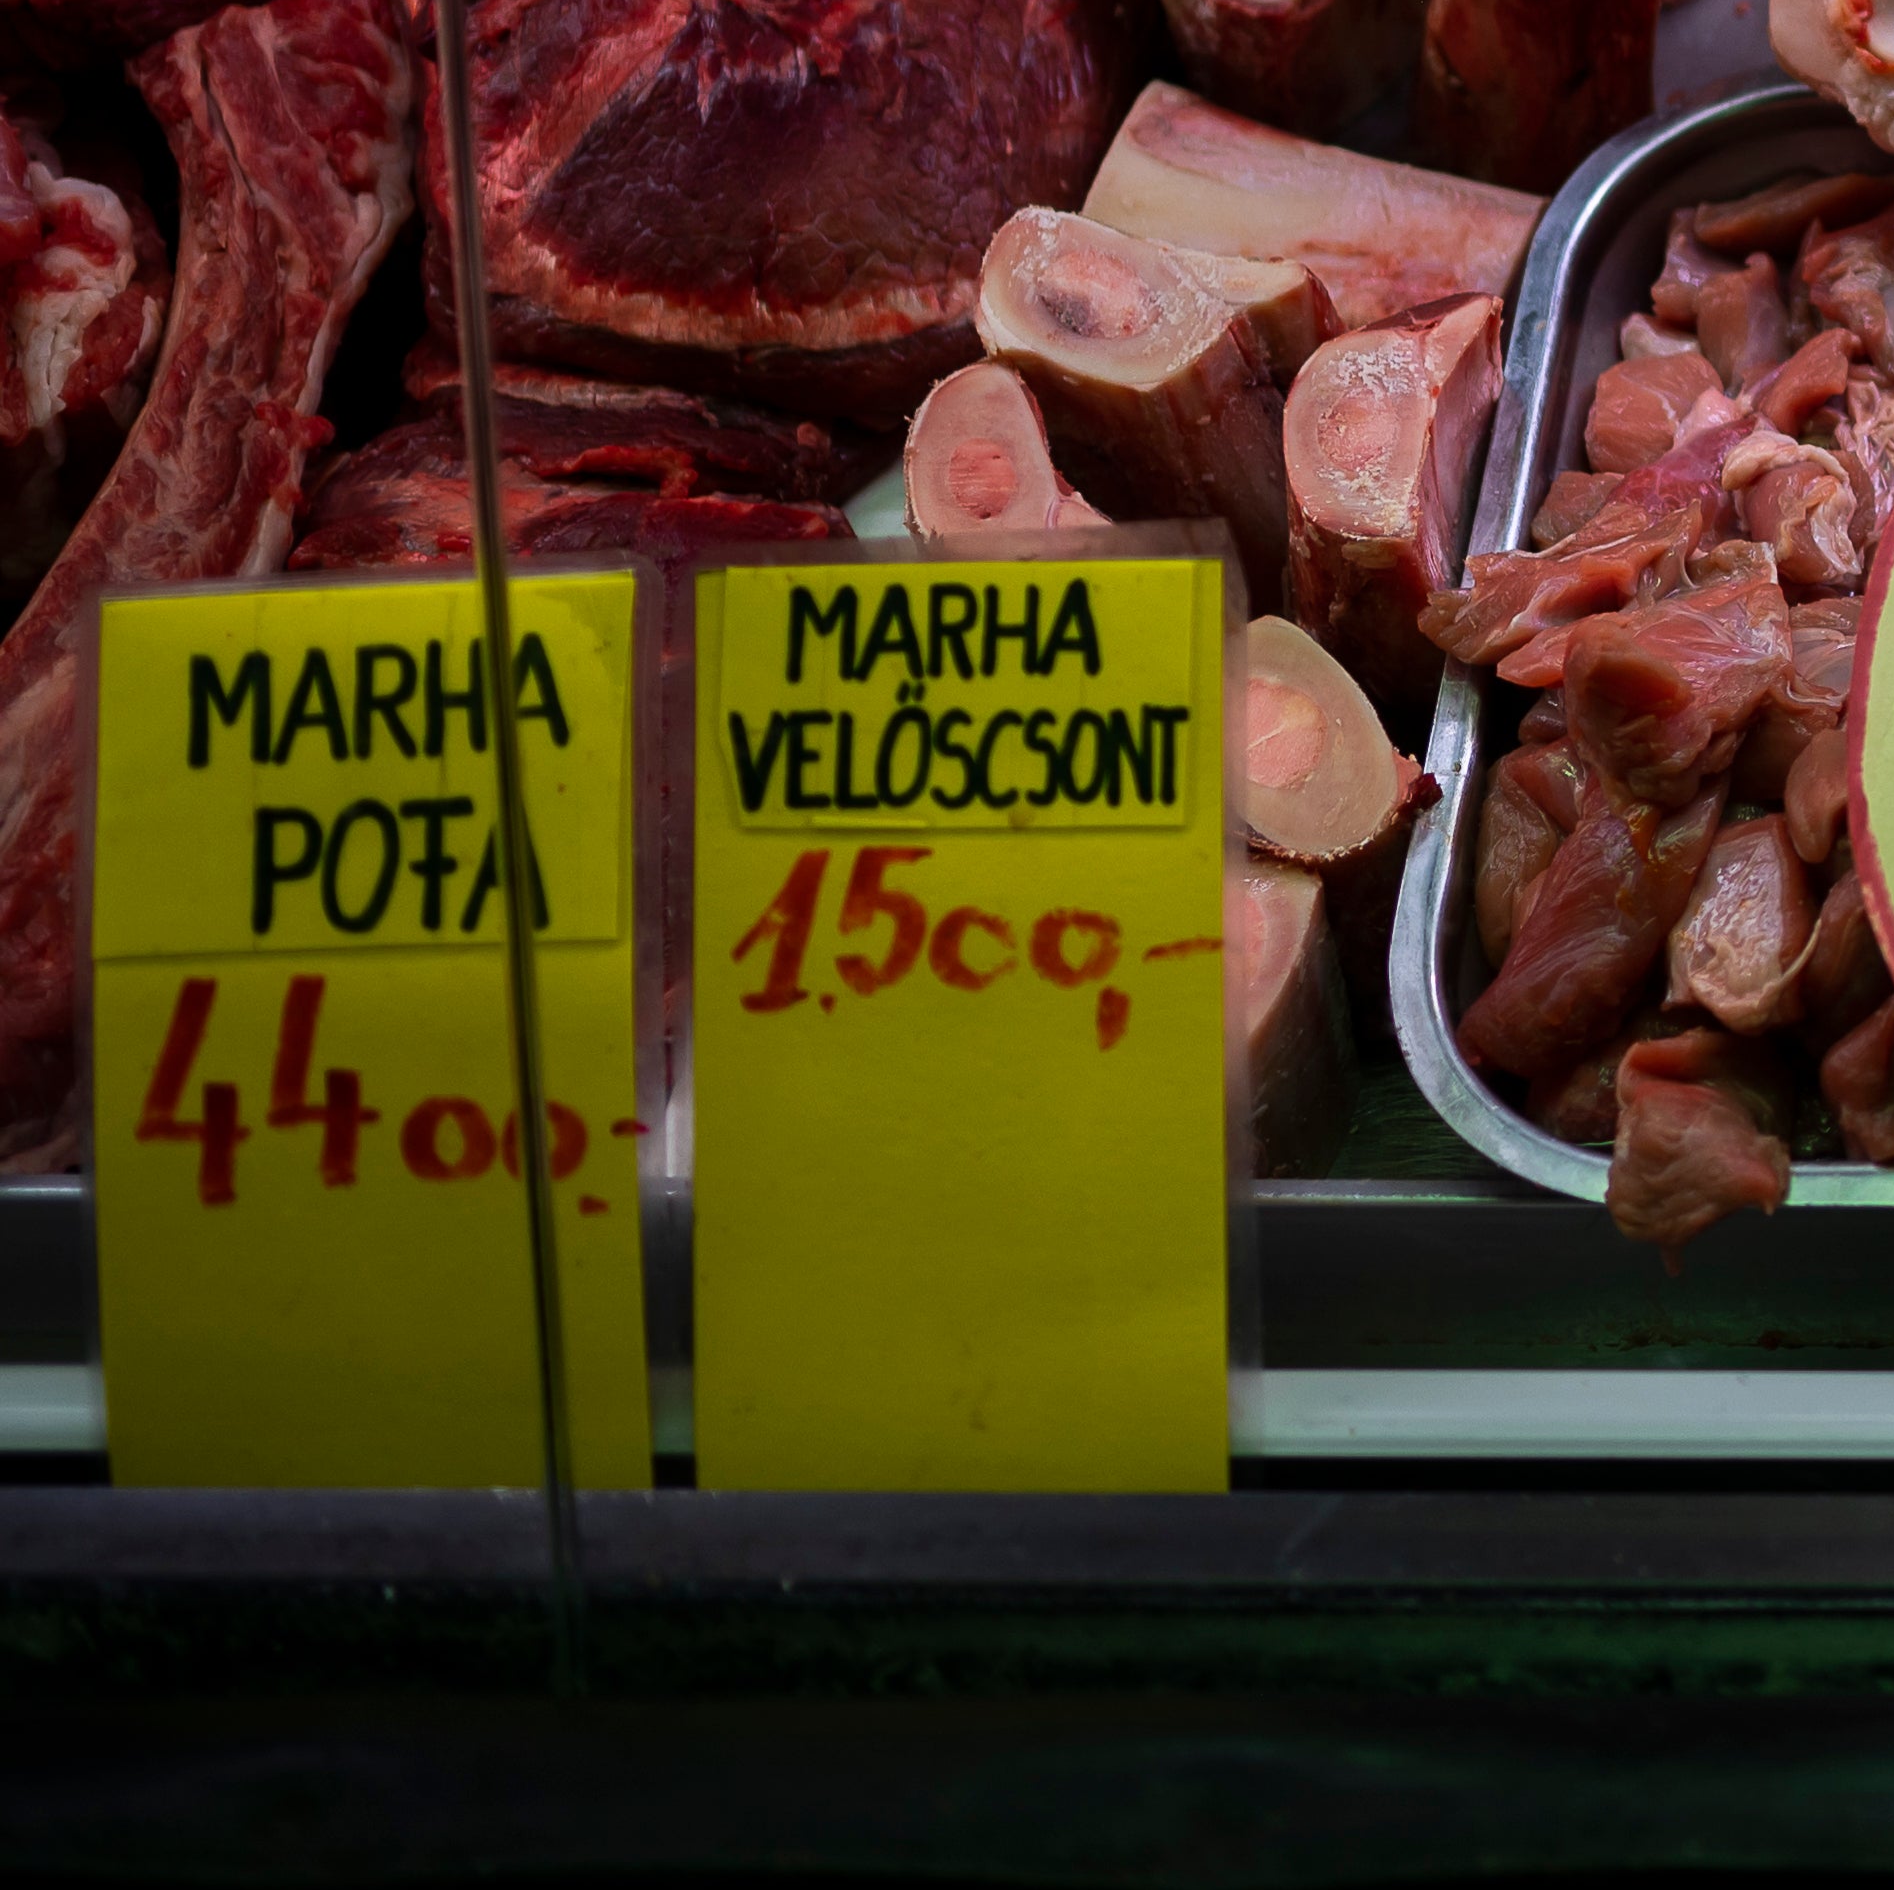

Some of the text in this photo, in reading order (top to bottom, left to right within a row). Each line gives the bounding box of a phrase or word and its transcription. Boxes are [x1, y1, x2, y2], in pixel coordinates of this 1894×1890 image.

[786, 578, 1102, 684] MARHA
[188, 632, 570, 769] MARHA
[729, 682, 1189, 812] VELŐSCSONT
